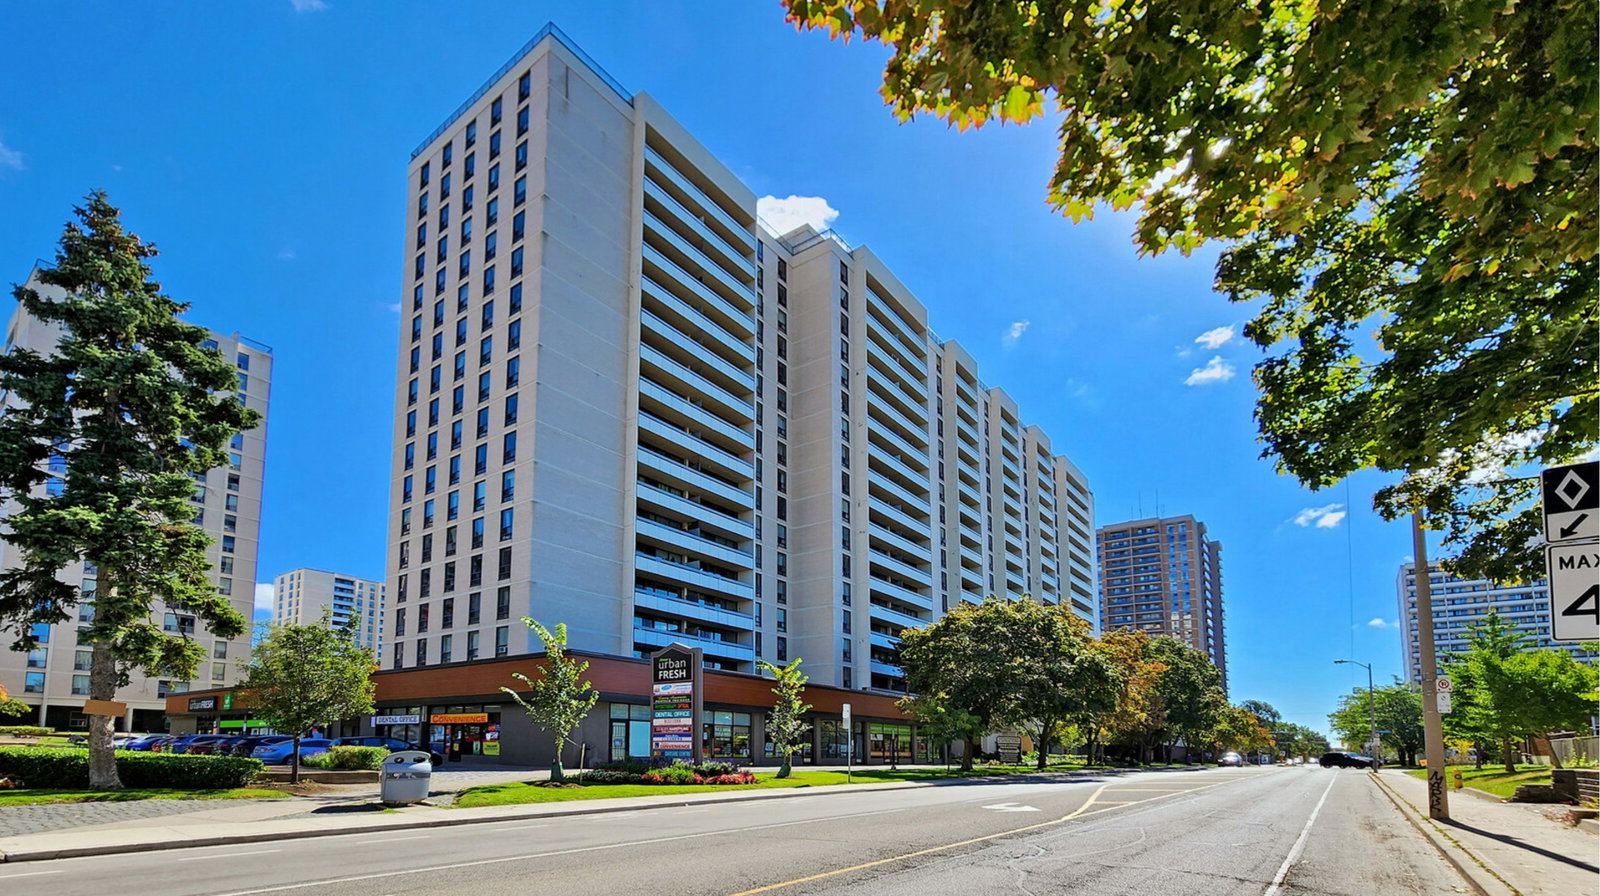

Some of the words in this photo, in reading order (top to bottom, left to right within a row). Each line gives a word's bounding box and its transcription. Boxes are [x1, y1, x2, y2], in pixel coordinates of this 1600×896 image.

[658, 658, 686, 669] urban
[658, 669, 686, 679] FRESH
[378, 715, 398, 723] DENTAL
[431, 714, 487, 723] CONVENIENCE
